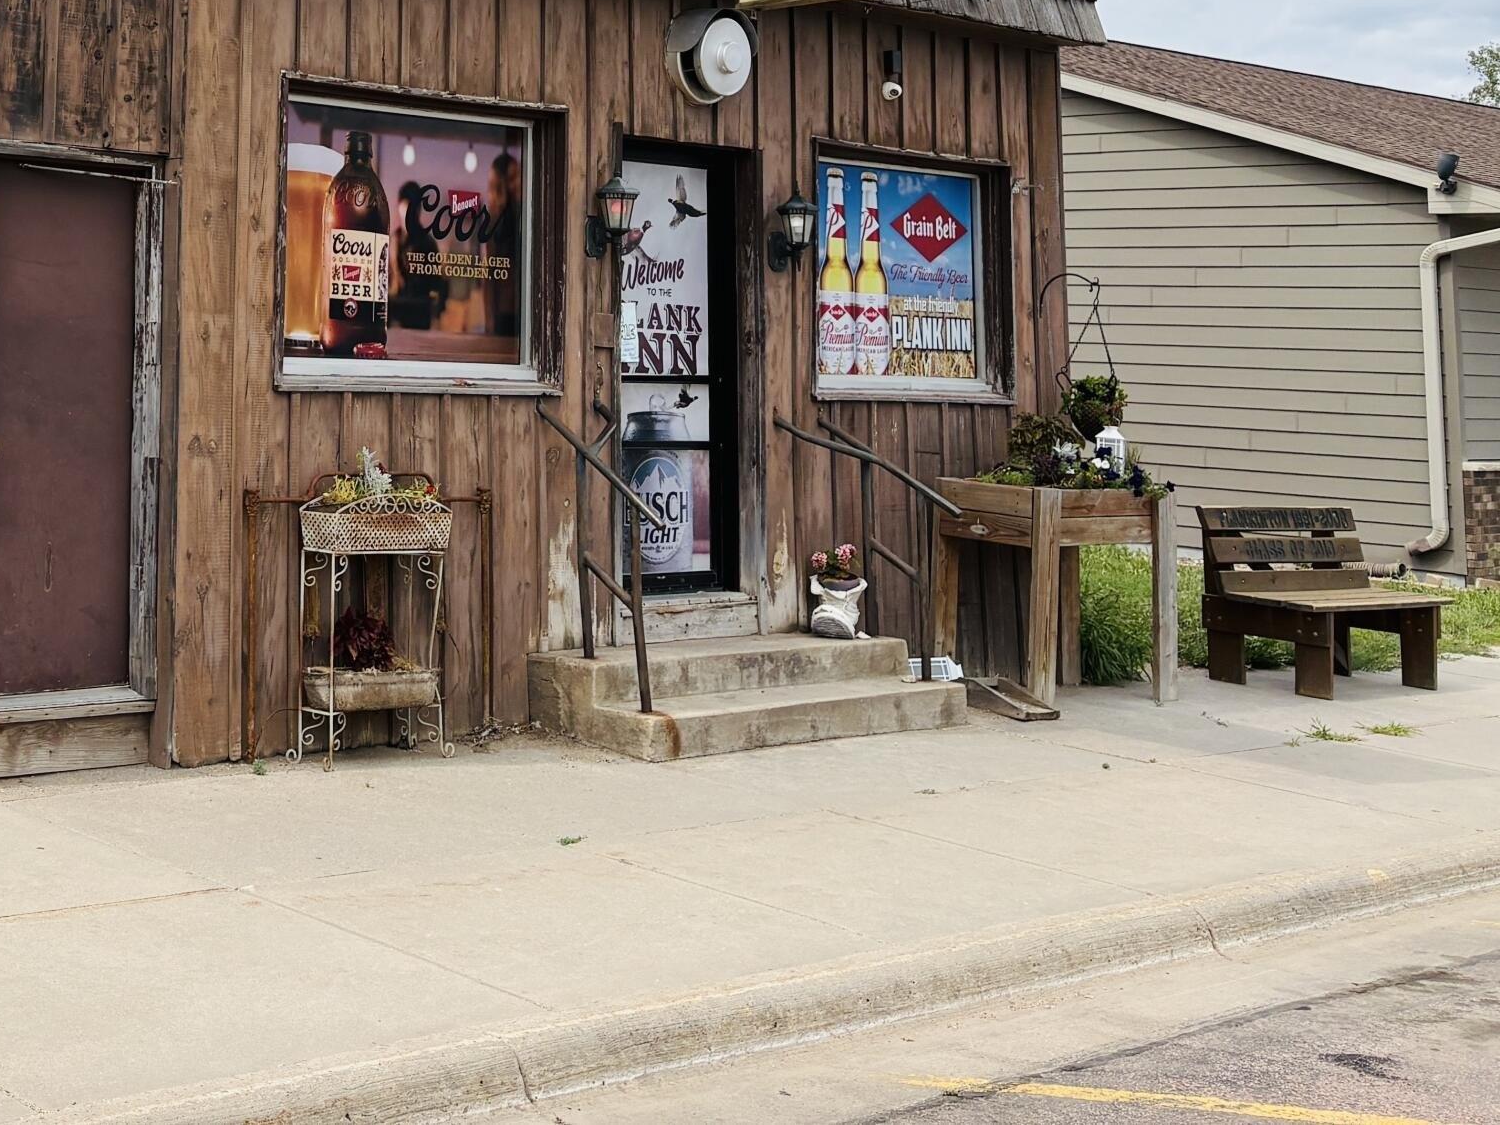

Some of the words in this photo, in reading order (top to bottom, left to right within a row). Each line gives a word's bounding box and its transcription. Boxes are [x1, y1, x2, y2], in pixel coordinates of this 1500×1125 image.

[903, 211, 933, 239] Grain
[935, 215, 957, 241] Belt
[332, 233, 372, 256] Coors
[406, 252, 425, 263] THE
[427, 252, 472, 266] GOLDEN
[475, 254, 511, 268] LAGER
[409, 263, 442, 276] FROM
[493, 269, 509, 280] CO
[621, 256, 684, 291] Welcome
[891, 263, 908, 281] The
[910, 265, 945, 289] Friendly
[947, 268, 968, 285] Beer
[332, 283, 372, 297] BEER
[647, 287, 657, 296] TO
[659, 288, 672, 297] THE
[903, 296, 913, 311] at
[914, 294, 927, 312] the
[929, 295, 959, 315] friendly
[621, 300, 702, 334] ANK
[891, 315, 944, 351] PLANK
[945, 317, 972, 351] INN
[621, 332, 700, 375] NN
[640, 527, 679, 544] IGHT
